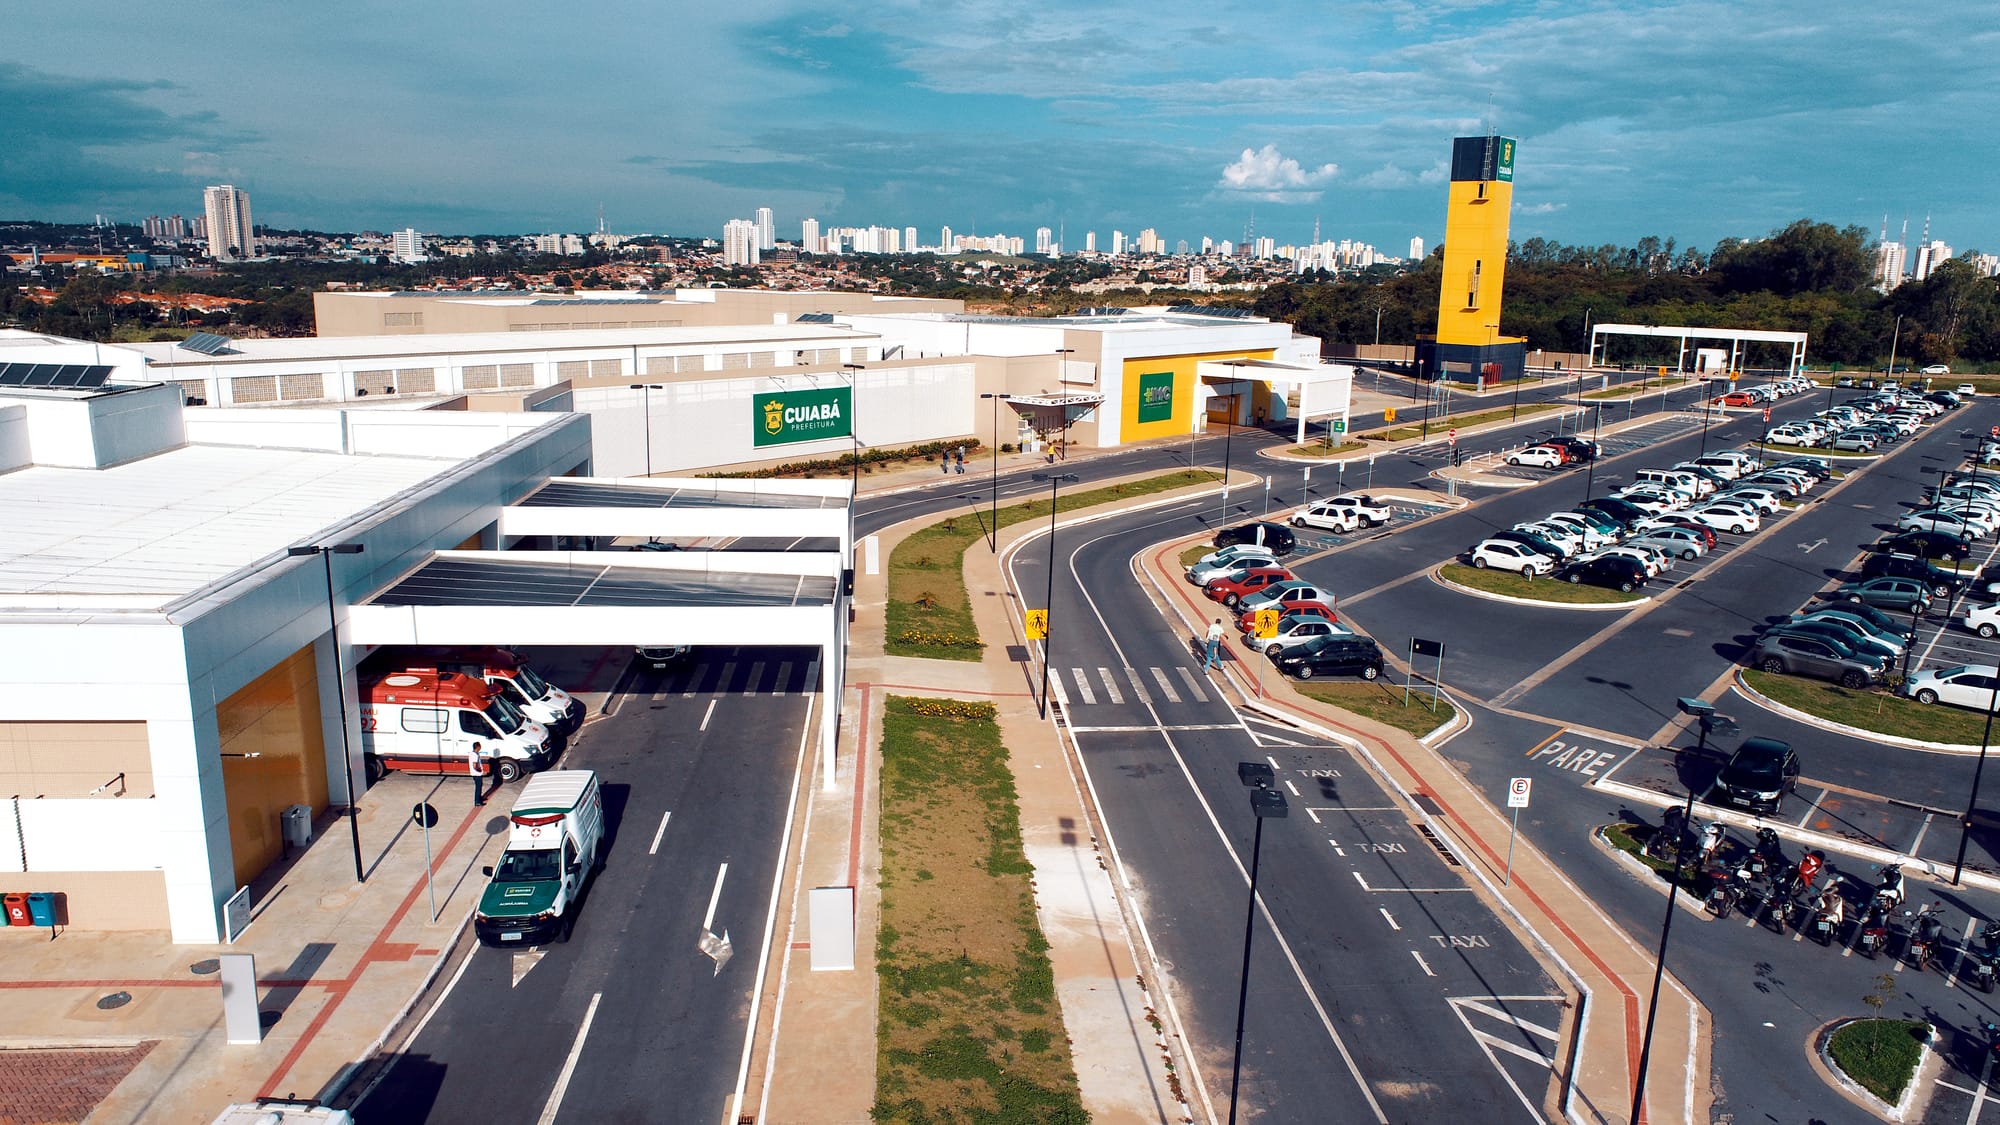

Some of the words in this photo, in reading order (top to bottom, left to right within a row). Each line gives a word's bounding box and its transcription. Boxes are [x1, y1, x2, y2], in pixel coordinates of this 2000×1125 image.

[784, 398, 840, 424] CUIABÁ
[791, 420, 835, 431] PREFEITURA
[361, 717, 378, 731] 92
[1530, 741, 1616, 776] PARE
[1295, 769, 1342, 778] TAXI
[1516, 782, 1525, 792] E
[1353, 843, 1408, 853] TAXI
[1429, 935, 1490, 948] TAXI
